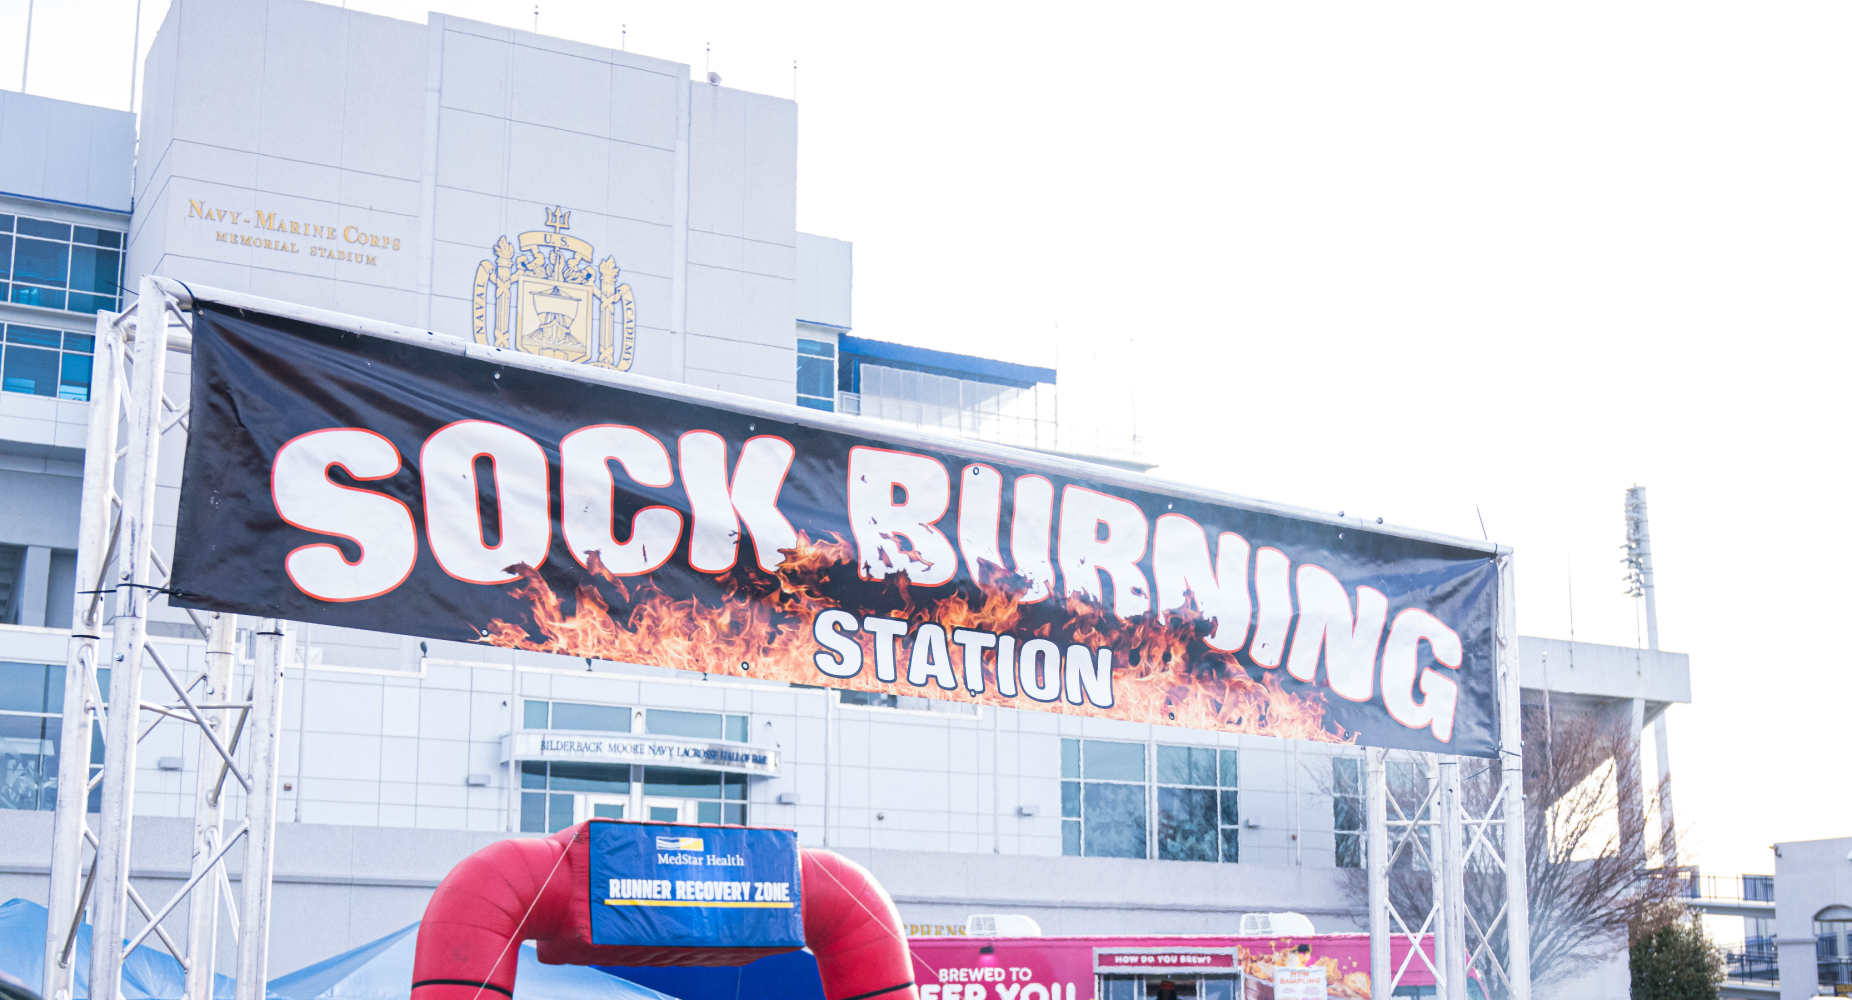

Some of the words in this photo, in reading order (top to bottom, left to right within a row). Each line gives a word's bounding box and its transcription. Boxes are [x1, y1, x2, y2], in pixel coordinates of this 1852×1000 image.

[216, 231, 299, 254] MEMORIAL
[310, 246, 377, 266] STADIUM
[343, 225, 401, 251] CORPS
[475, 281, 485, 335] NAVAL
[622, 297, 634, 363] ACADEMY
[271, 418, 801, 602] SOCK
[848, 444, 1462, 743] BURNING
[812, 608, 1115, 709] STATION
[541, 740, 603, 752] BILDERBACK
[608, 742, 645, 754] MOORE
[648, 744, 675, 757] NAVY
[657, 853, 704, 866] MedStar
[706, 854, 745, 866] Health
[609, 878, 672, 899] RUNNER
[675, 880, 751, 901] RECOVERY
[753, 882, 790, 902] ZONE
[1114, 954, 1138, 964] HOW
[1140, 955, 1155, 964] DO
[1157, 955, 1178, 964] YOU
[1180, 955, 1212, 965] BREW?
[938, 967, 1005, 982] BREWED
[1009, 966, 1032, 981] TO
